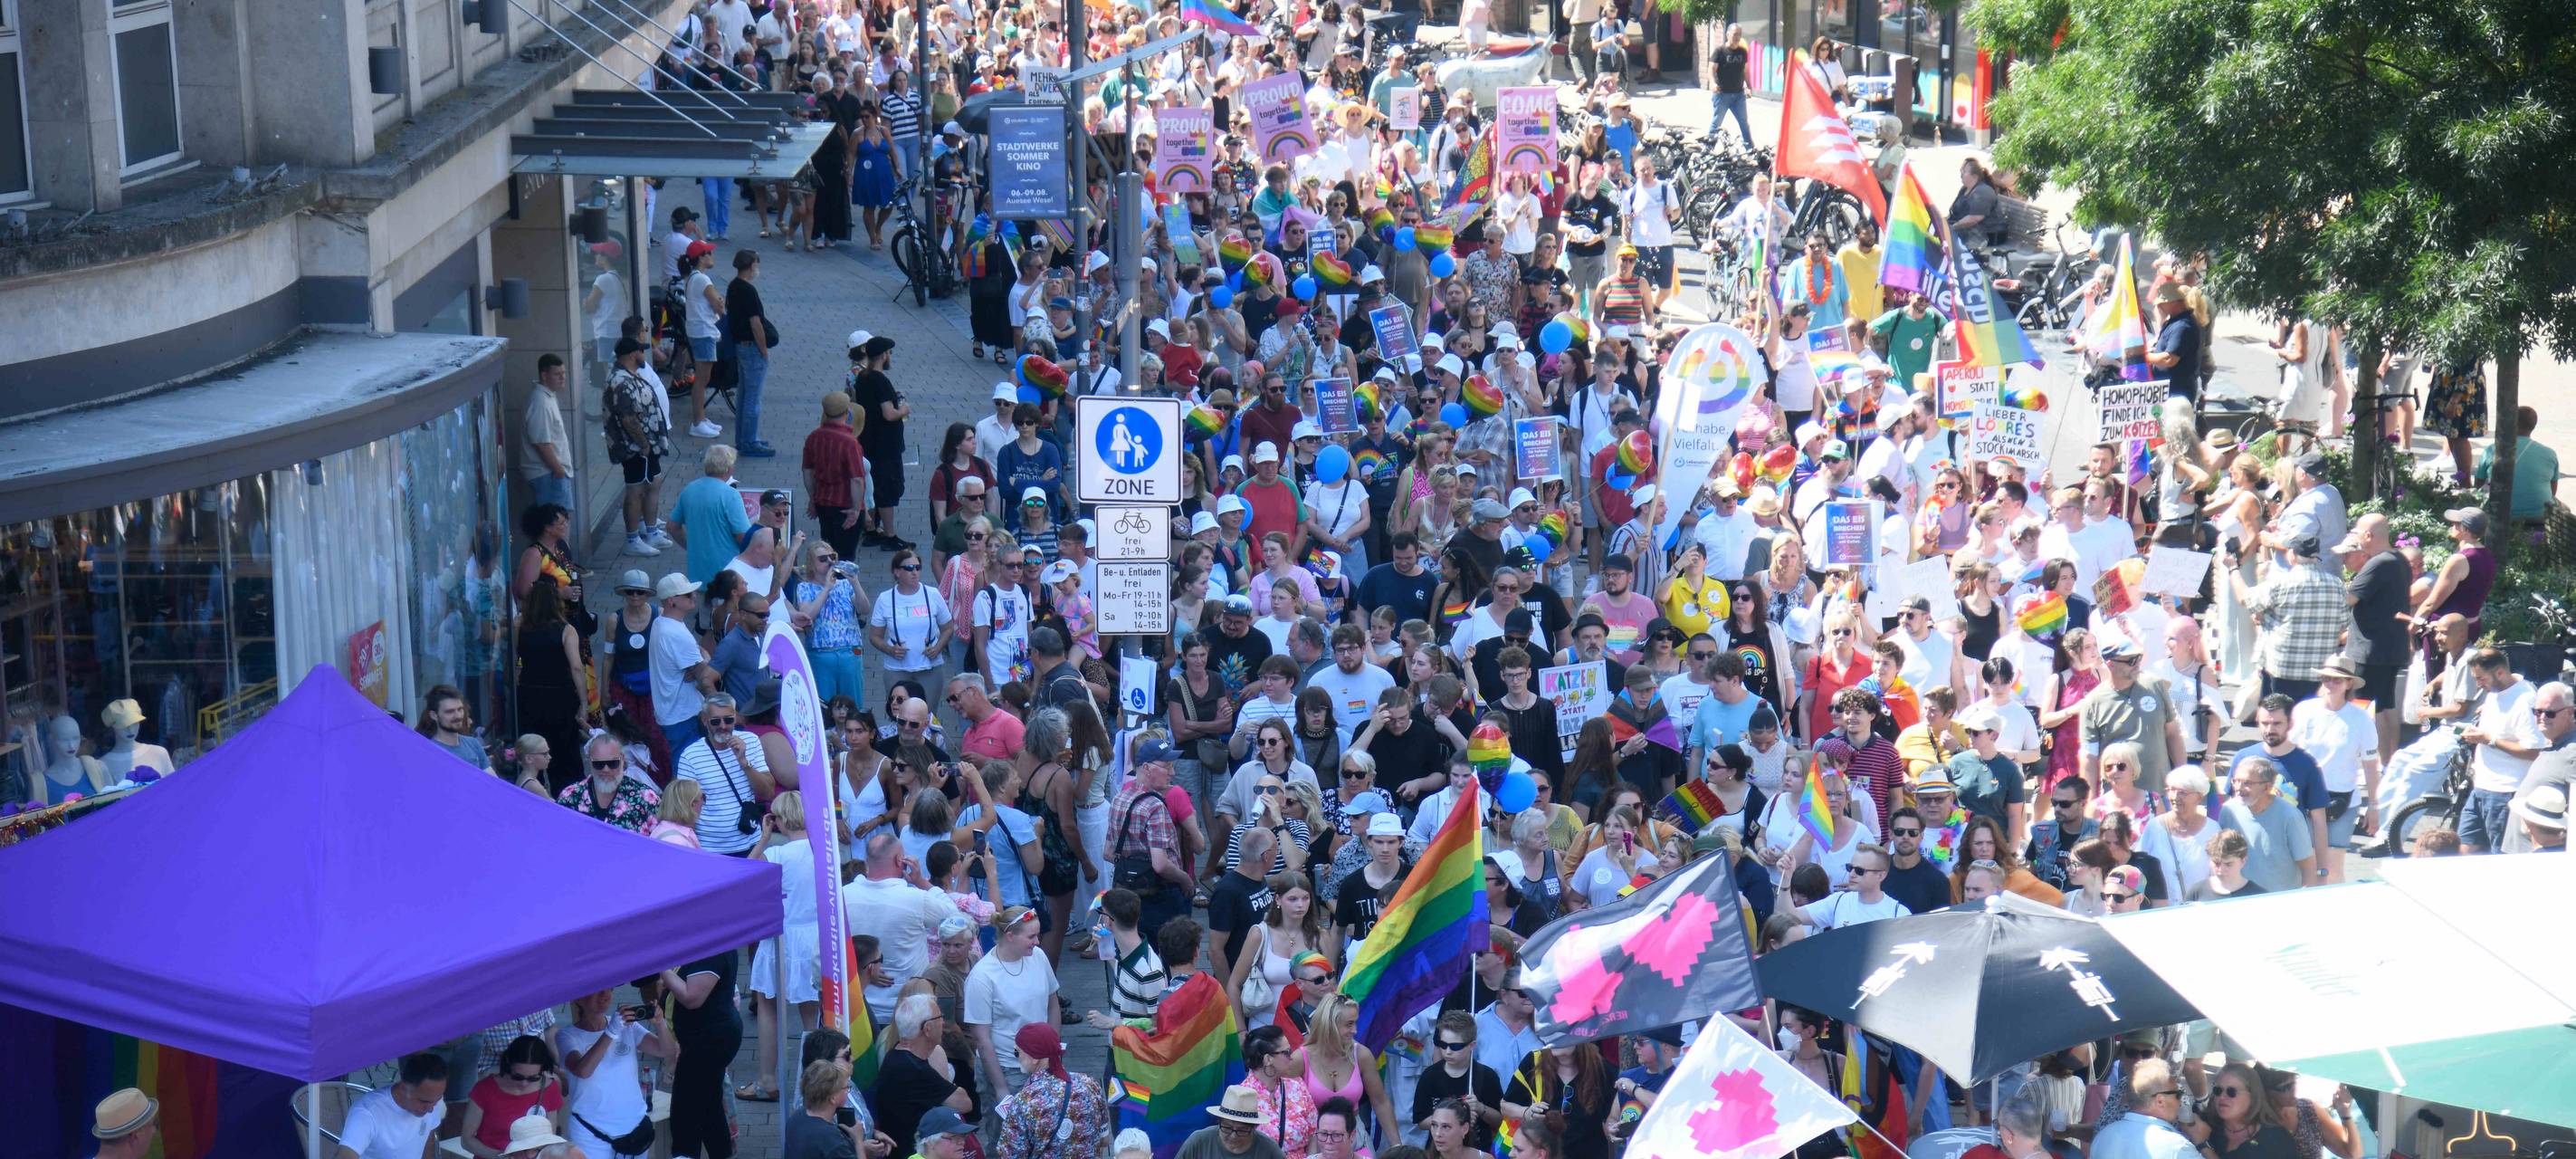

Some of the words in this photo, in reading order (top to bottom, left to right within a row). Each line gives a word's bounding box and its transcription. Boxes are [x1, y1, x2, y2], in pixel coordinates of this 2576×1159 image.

[1030, 72, 1054, 82] MEHR
[1247, 81, 1301, 108] PROUD
[1500, 94, 1555, 115] COME
[1259, 106, 1290, 119] together
[1160, 117, 1211, 134] PROUD
[1507, 117, 1539, 127] together
[997, 141, 1059, 151] STADTWERKE
[1166, 137, 1197, 148] together
[1007, 152, 1050, 161] SOMMER
[1016, 162, 1041, 171] KINO
[1011, 188, 1047, 196] 06.-09.08.
[1378, 318, 1392, 327] DAS
[1816, 339, 1831, 349] DAS
[1970, 381, 1995, 393] STATT
[1321, 390, 1336, 398] DAS
[2103, 384, 2169, 407] HOMOPHOBIE
[1985, 408, 2027, 422] LIEBER
[2103, 407, 2132, 425] FINDE
[2132, 406, 2147, 420] ICH
[1522, 431, 1538, 440] DAS
[1540, 430, 1551, 438] EIS
[2101, 425, 2123, 442] ZUM
[2123, 420, 2161, 439] KOTZEN
[1674, 437, 1719, 451] Vielfalt.
[1992, 435, 2007, 444] ALS
[1976, 442, 2007, 455] STOCK
[1103, 478, 1155, 495] ZONE
[1832, 515, 1850, 524] DAS
[1852, 514, 1865, 523] EIS
[1125, 537, 1141, 545] frei
[1103, 568, 1118, 577] Be-
[1129, 568, 1161, 577] Entladen
[1124, 579, 1141, 588] frei
[1103, 591, 1131, 599] Mo-Fr
[1104, 612, 1115, 620] Sa
[1545, 666, 1597, 693] KATZEN
[1562, 705, 1586, 715] STATT
